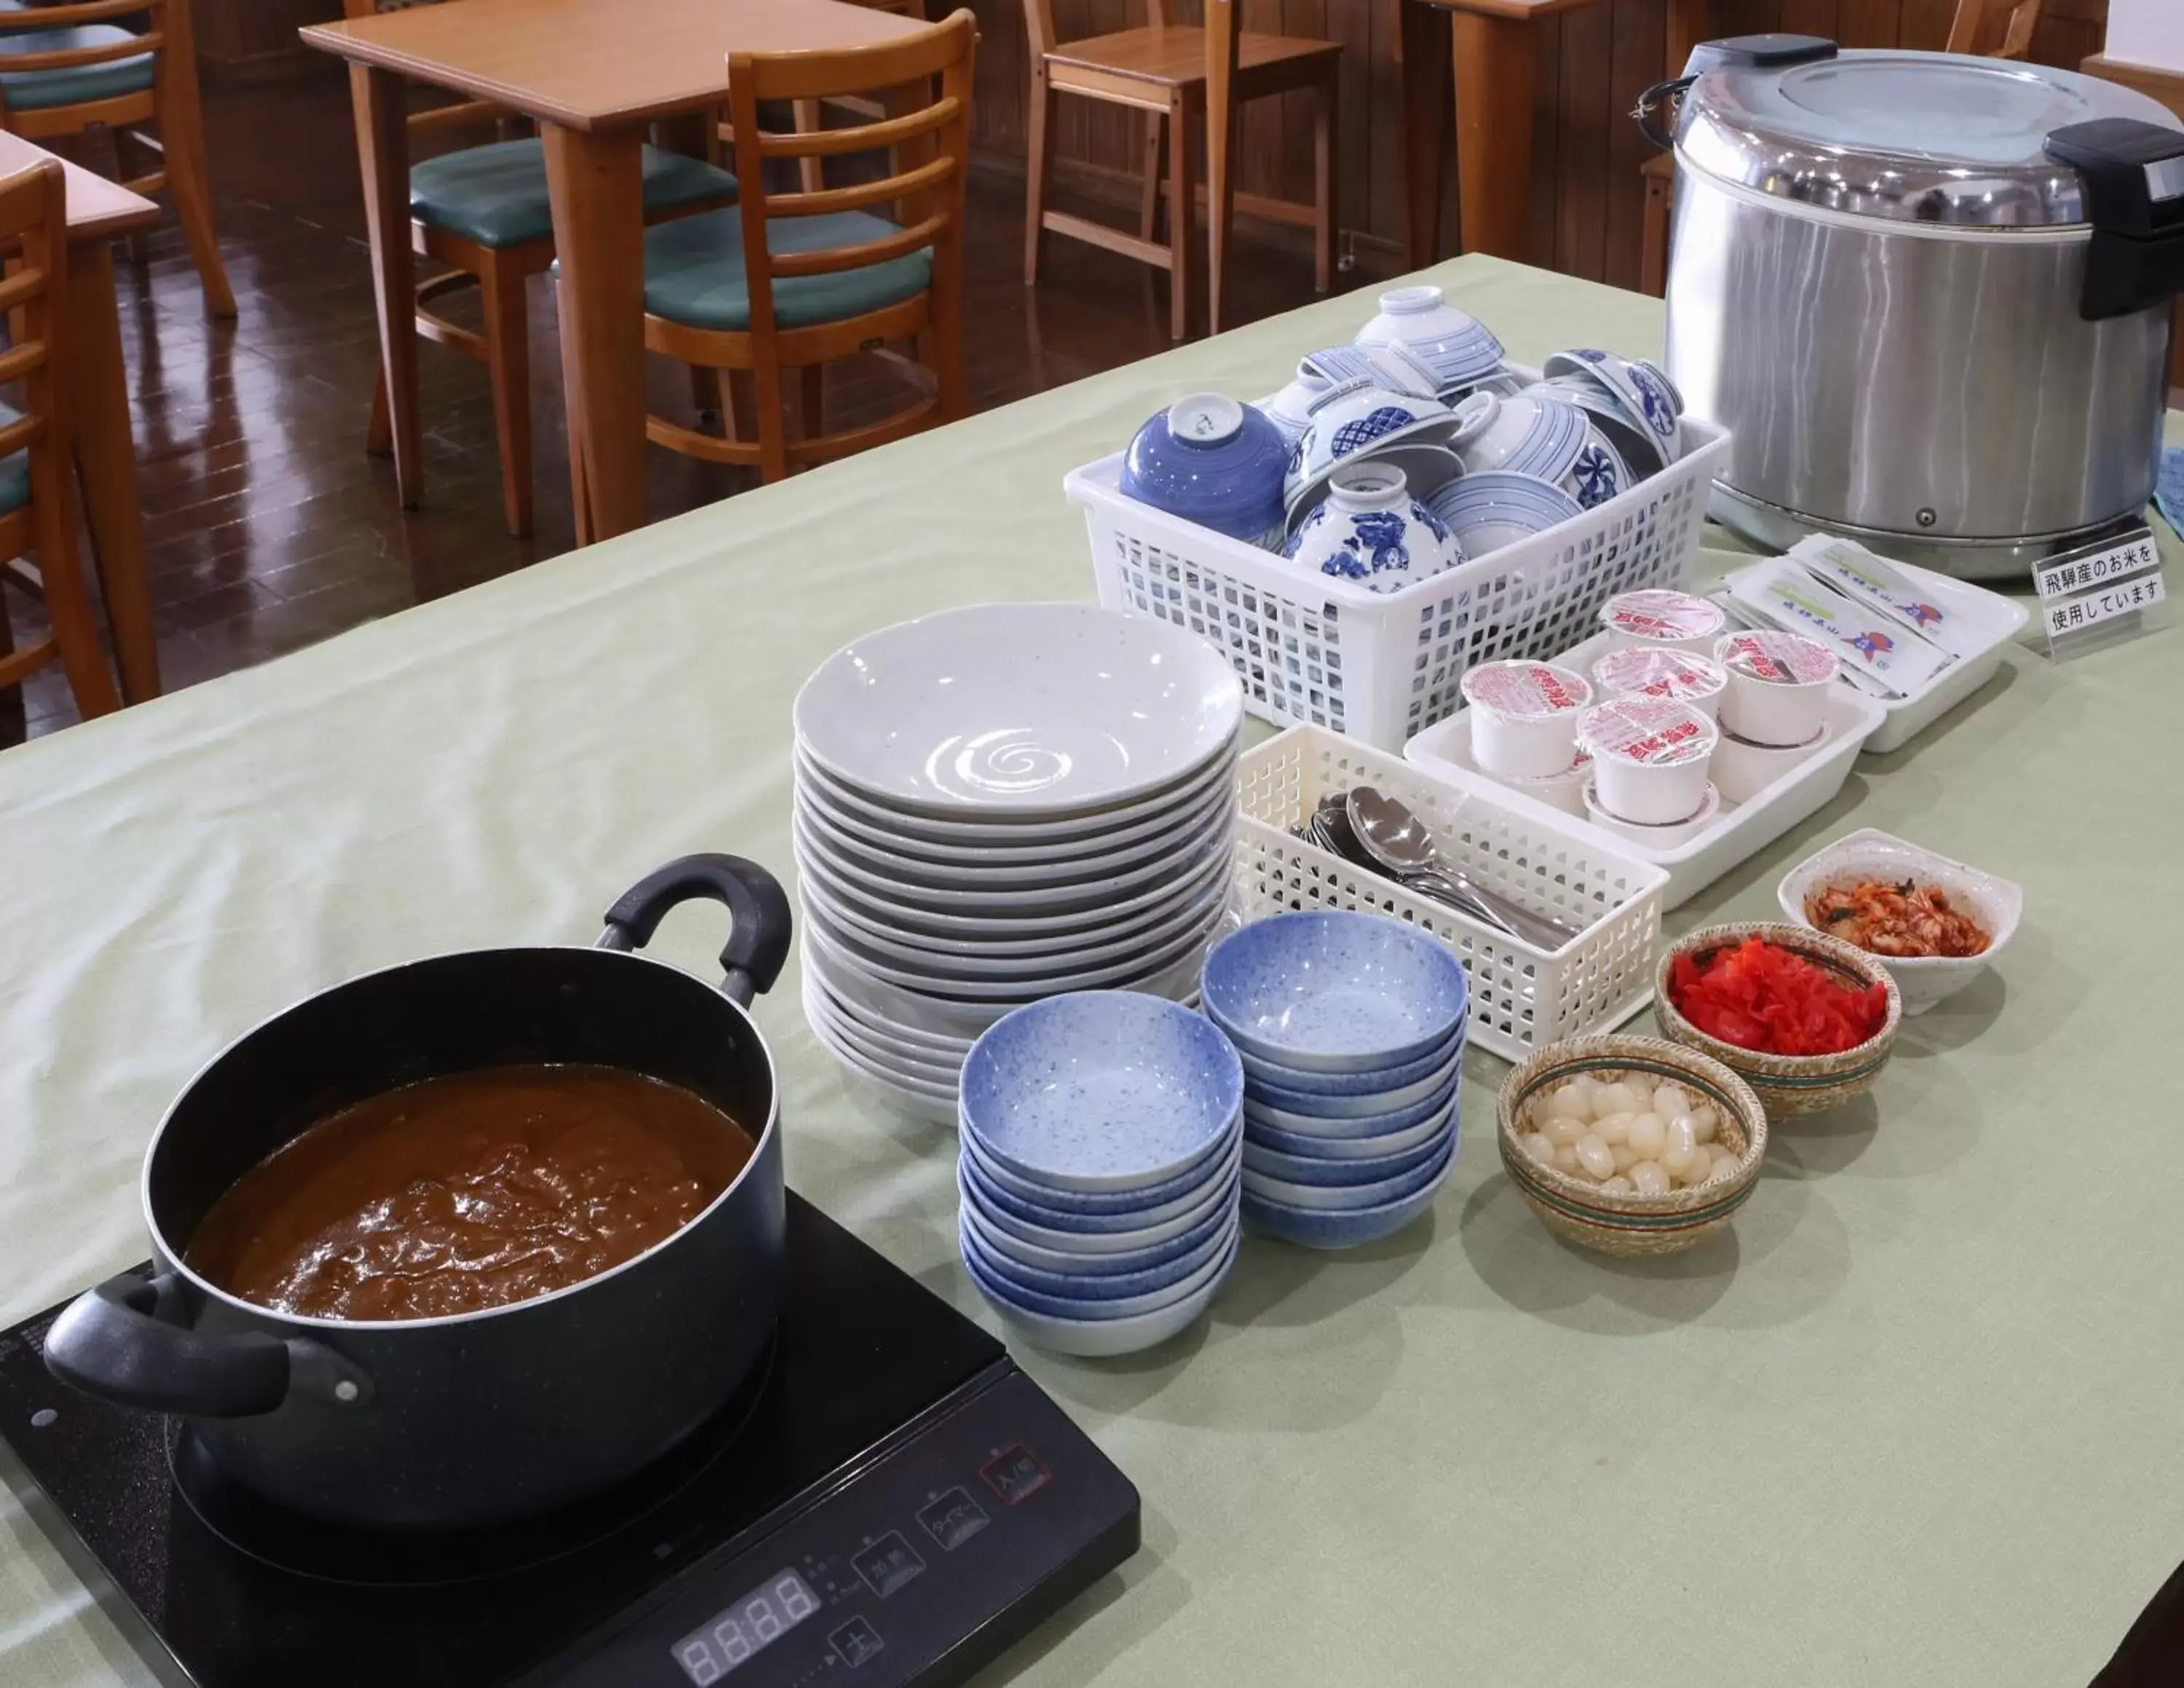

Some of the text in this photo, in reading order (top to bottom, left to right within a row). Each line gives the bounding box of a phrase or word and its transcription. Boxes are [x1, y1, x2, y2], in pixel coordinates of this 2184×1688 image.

[2044, 544, 2152, 595] 飛騨産のお米を
[2052, 579, 2158, 631] 使用しています
